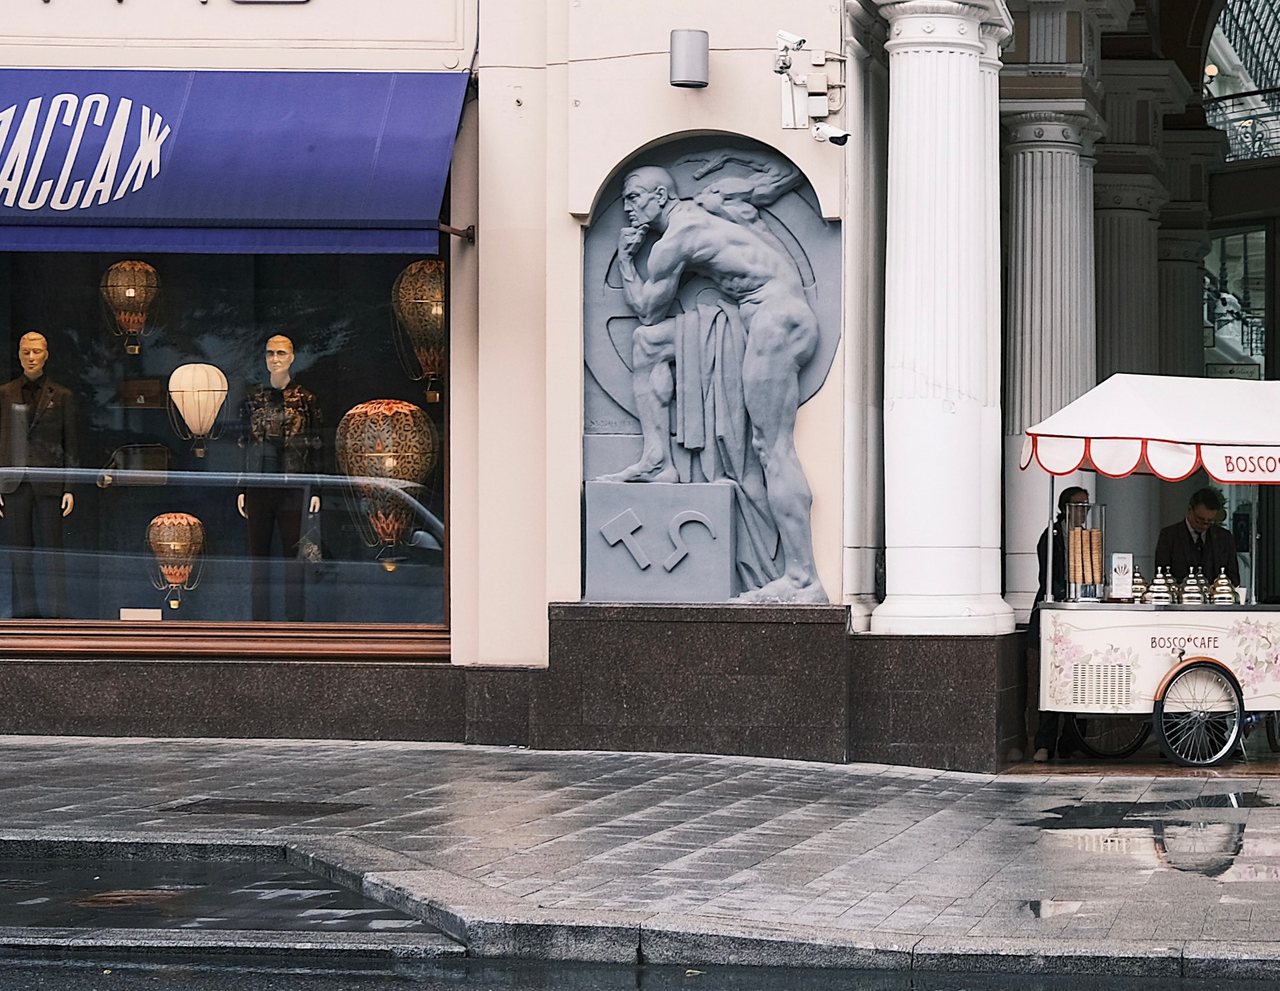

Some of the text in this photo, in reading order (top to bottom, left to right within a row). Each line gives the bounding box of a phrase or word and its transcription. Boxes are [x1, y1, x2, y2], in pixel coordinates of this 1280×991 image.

[0, 93, 171, 210] АССАЖ
[1225, 456, 1277, 473] BOSCO
[1151, 637, 1219, 648] BOSCO CAFE
